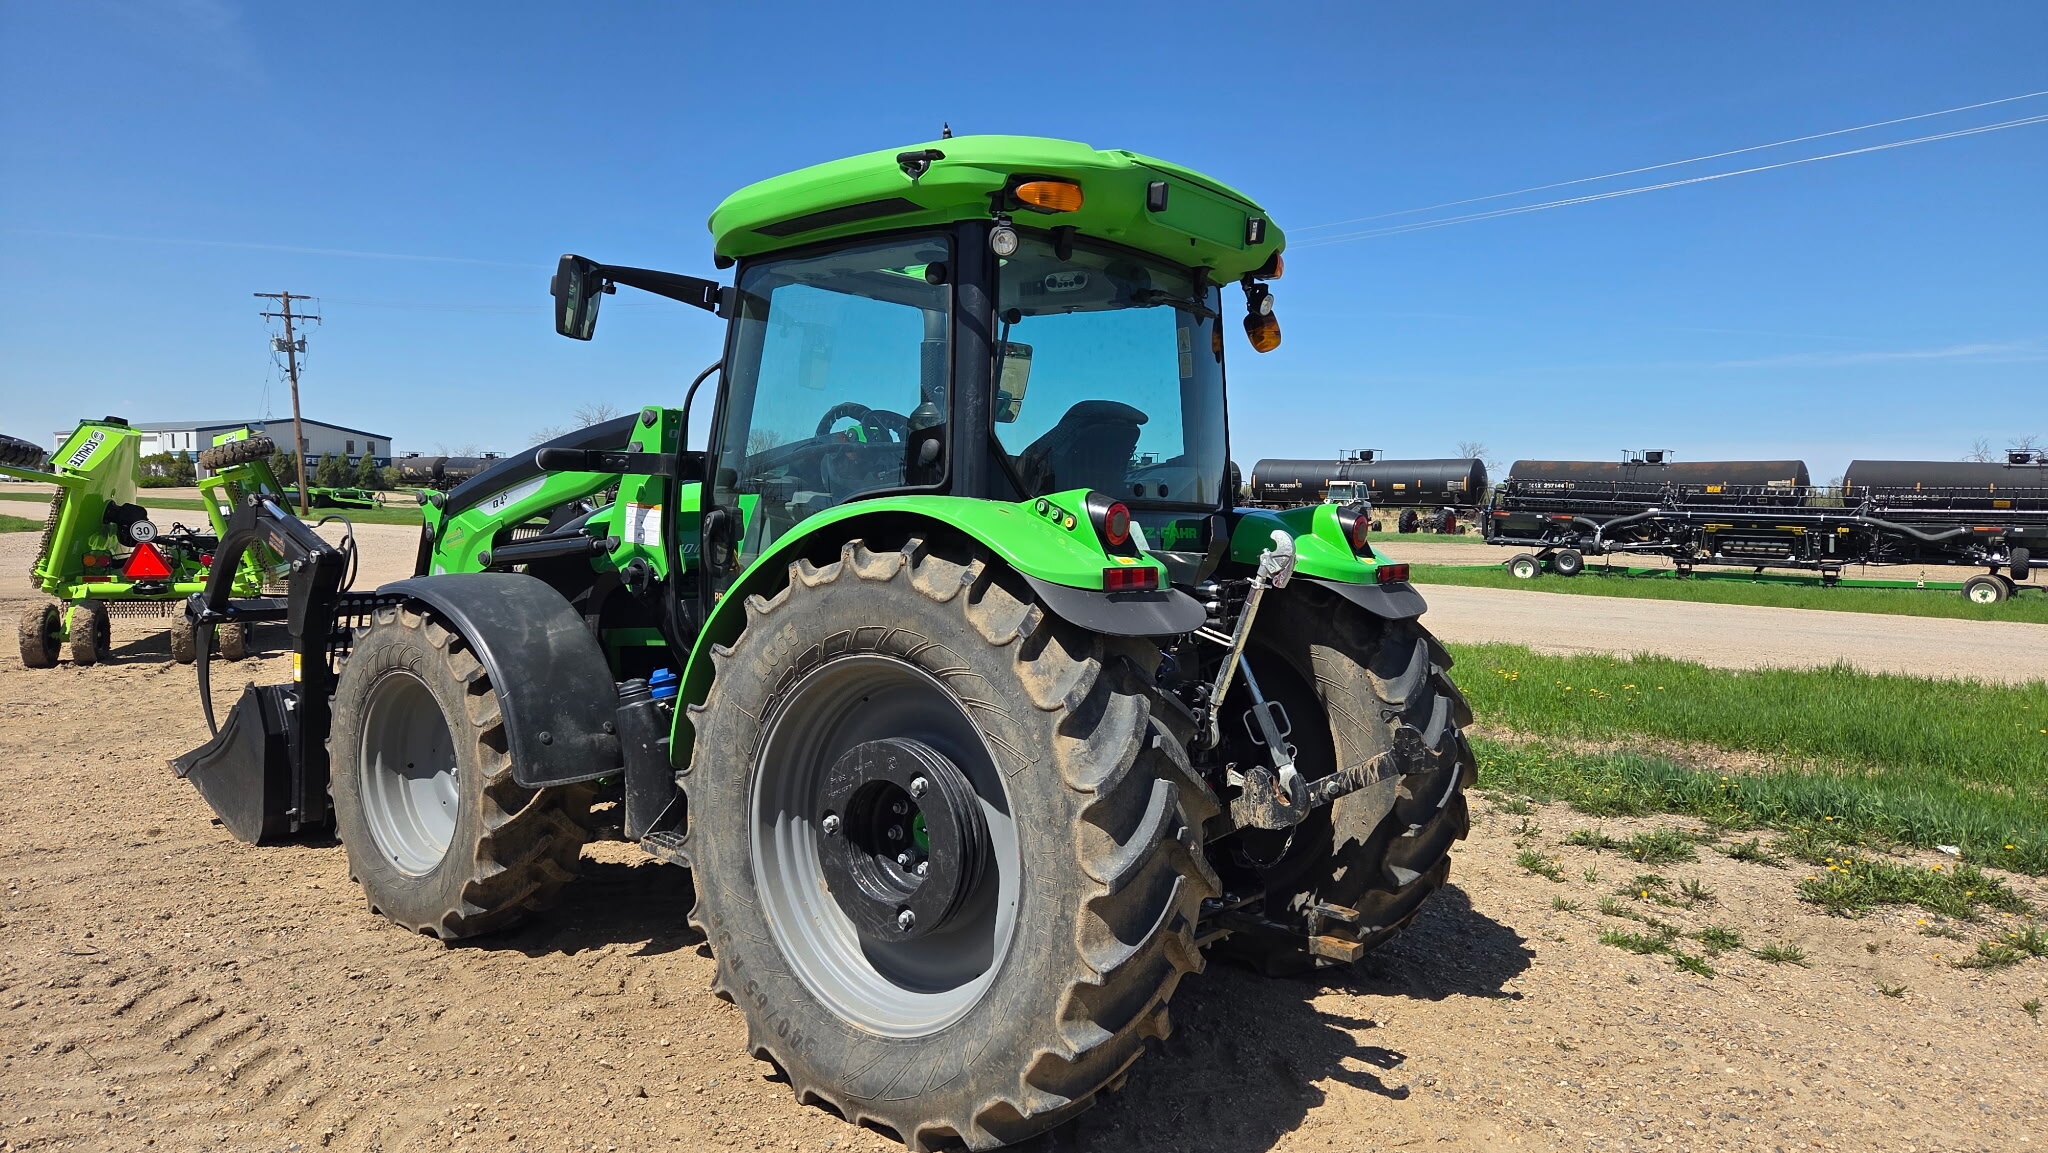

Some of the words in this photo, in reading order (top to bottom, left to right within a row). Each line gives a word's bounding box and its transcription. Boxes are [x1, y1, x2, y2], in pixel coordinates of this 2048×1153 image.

[69, 439, 99, 467] SCHULTE
[348, 458, 383, 467] VAEY
[135, 526, 150, 536] 30
[1142, 527, 1197, 539] Z-FAHR
